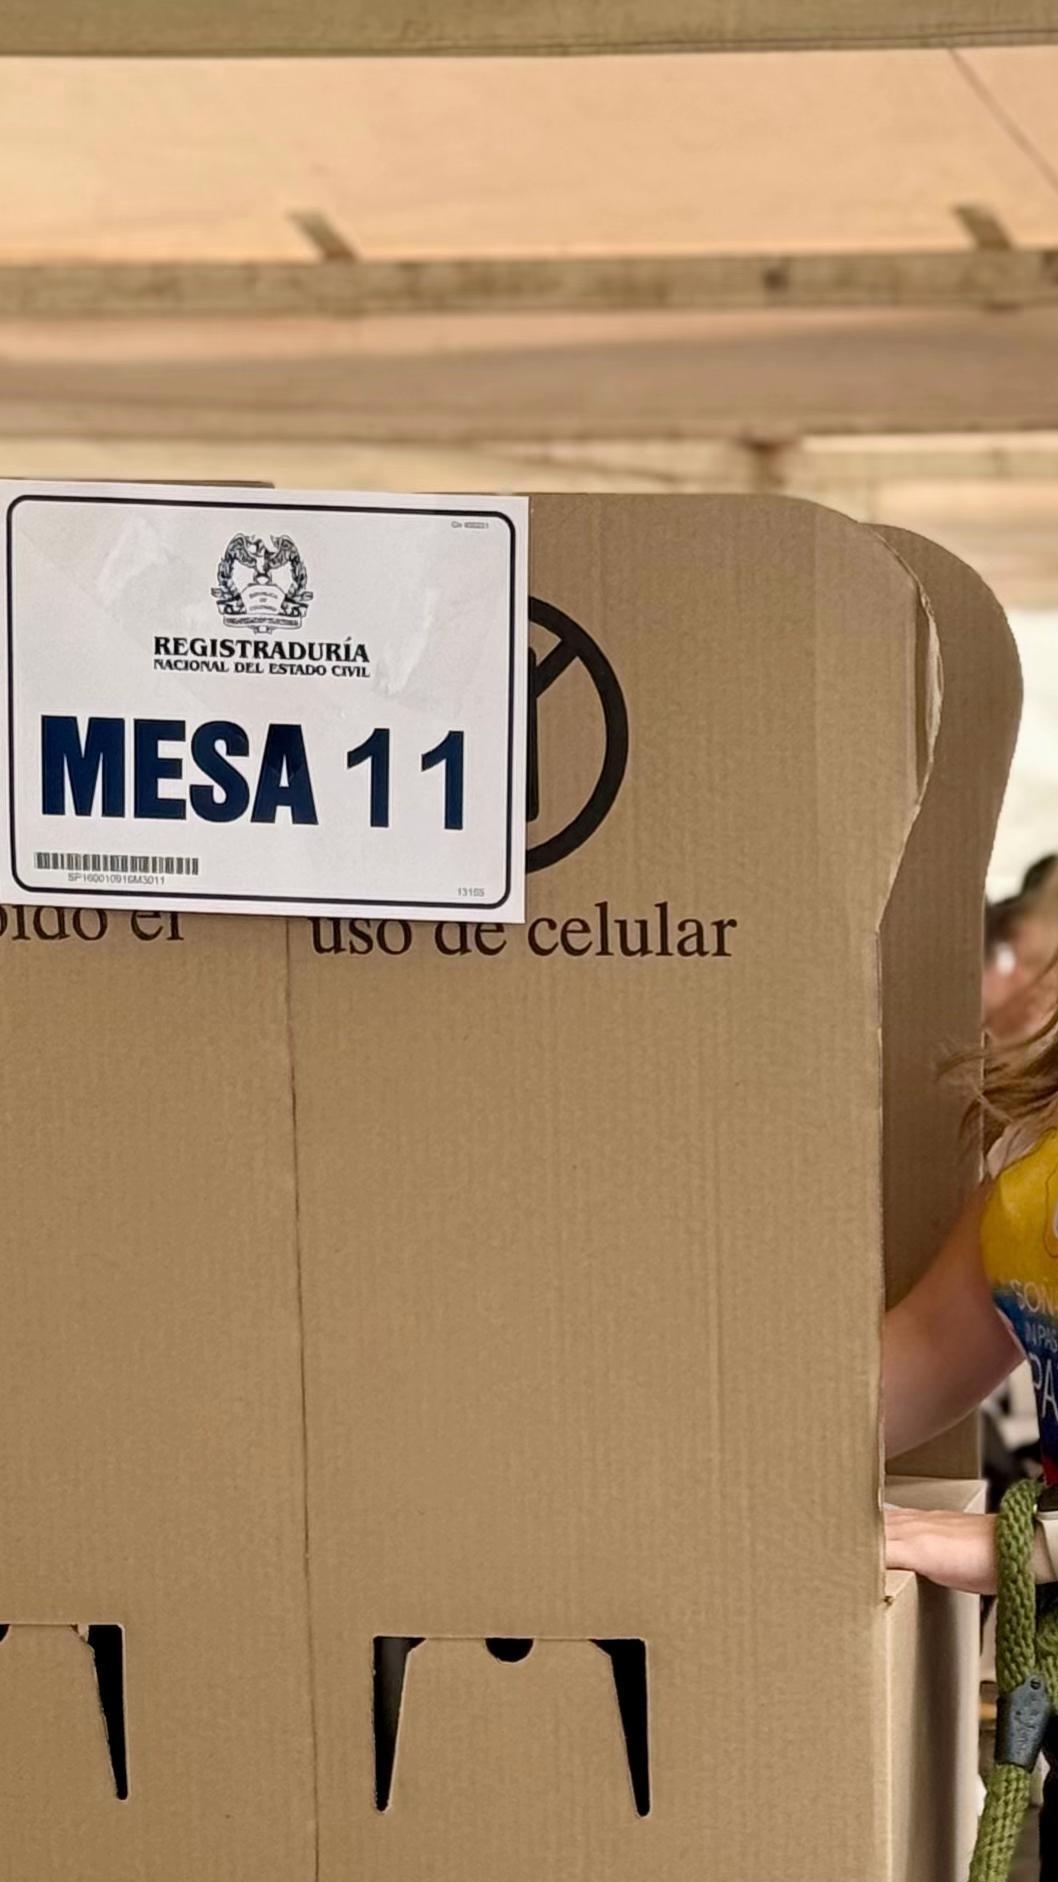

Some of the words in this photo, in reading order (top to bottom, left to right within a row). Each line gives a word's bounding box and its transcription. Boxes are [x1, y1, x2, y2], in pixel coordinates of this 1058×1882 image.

[153, 659, 229, 673] NACIONAL
[234, 662, 264, 674] DEL
[269, 663, 326, 677] ESTADO
[332, 665, 370, 678] CIVIL
[154, 636, 370, 663] REGISTRADURÍA
[41, 714, 318, 825] MESA
[346, 727, 465, 831] 11
[0, 904, 109, 941] ido
[311, 916, 413, 956] uso
[434, 920, 507, 957] de
[527, 901, 737, 957] celular
